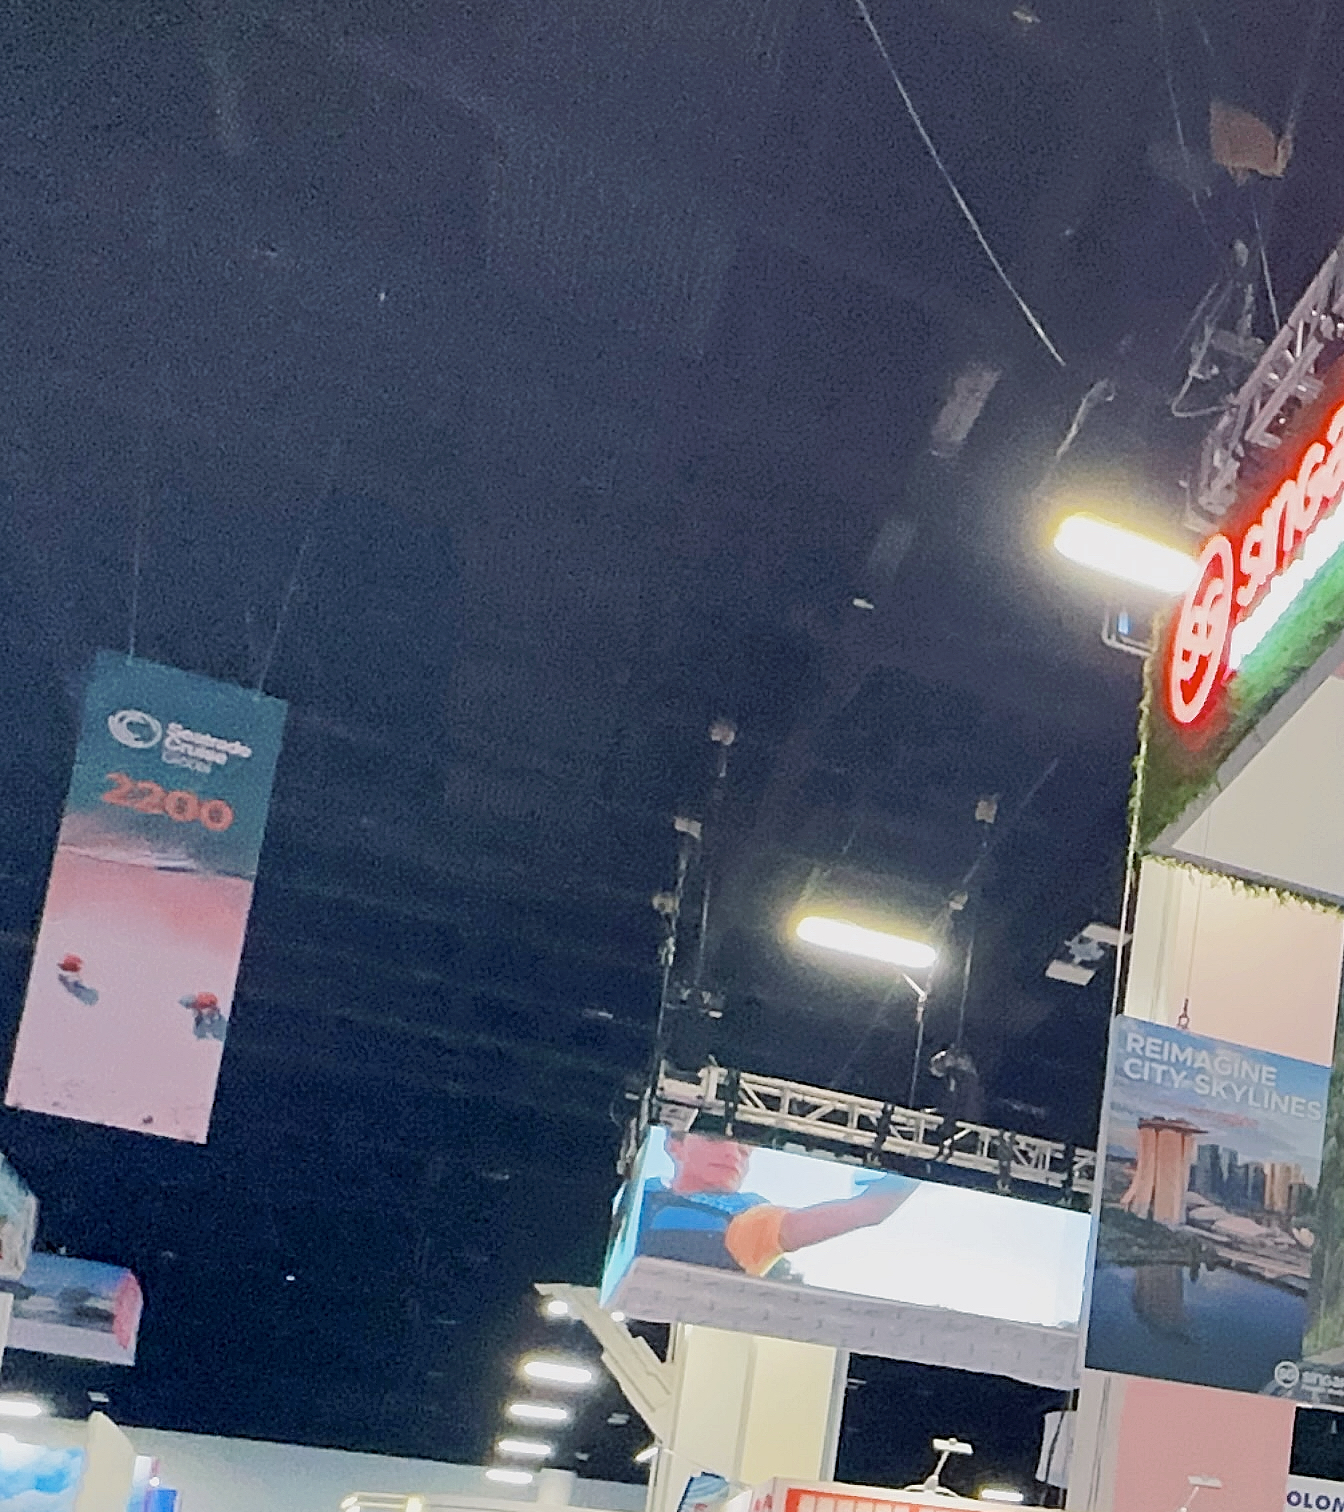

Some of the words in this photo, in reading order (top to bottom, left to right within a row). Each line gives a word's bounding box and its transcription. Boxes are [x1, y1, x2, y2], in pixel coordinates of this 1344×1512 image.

[102, 771, 234, 833] 2200
[1122, 1057, 1188, 1089] CITY
[1194, 1074, 1322, 1122] SKYLINES
[1126, 1031, 1278, 1087] REIMAGINE
